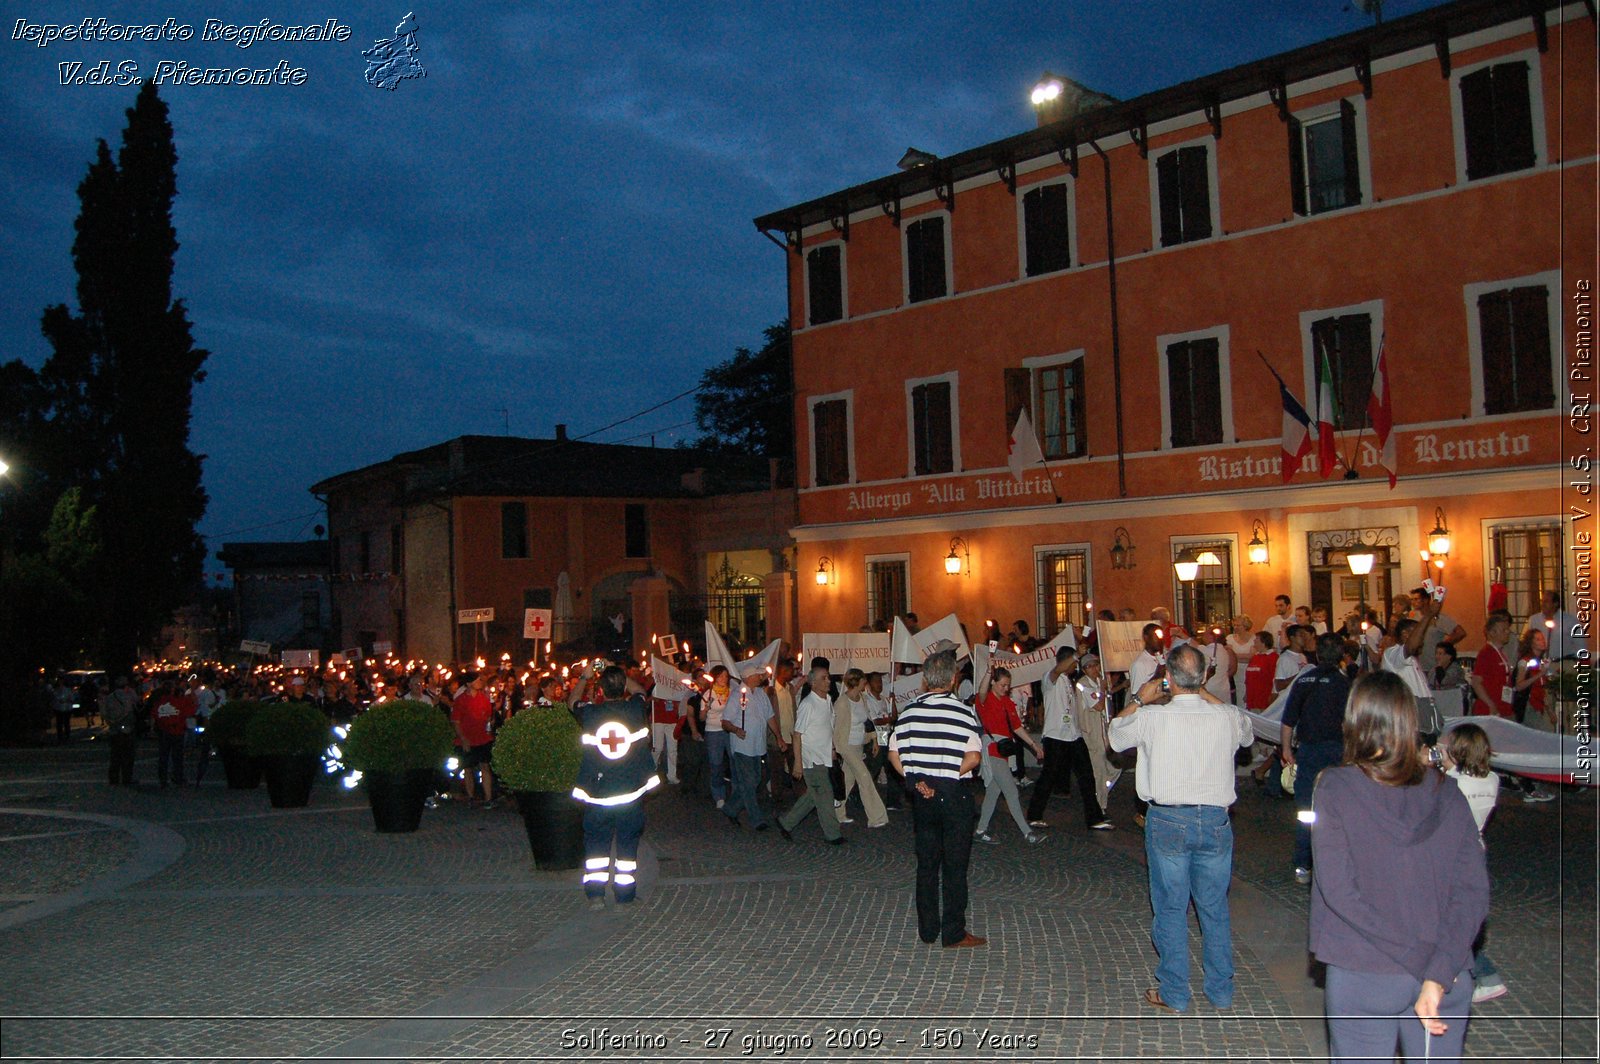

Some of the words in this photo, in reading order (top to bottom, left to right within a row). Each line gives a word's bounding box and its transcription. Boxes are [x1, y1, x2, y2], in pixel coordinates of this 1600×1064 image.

[1413, 431, 1531, 464] Renato
[846, 491, 911, 511] Albergo
[807, 647, 852, 660] VOLUNTARY
[854, 647, 890, 659] SERVICE
